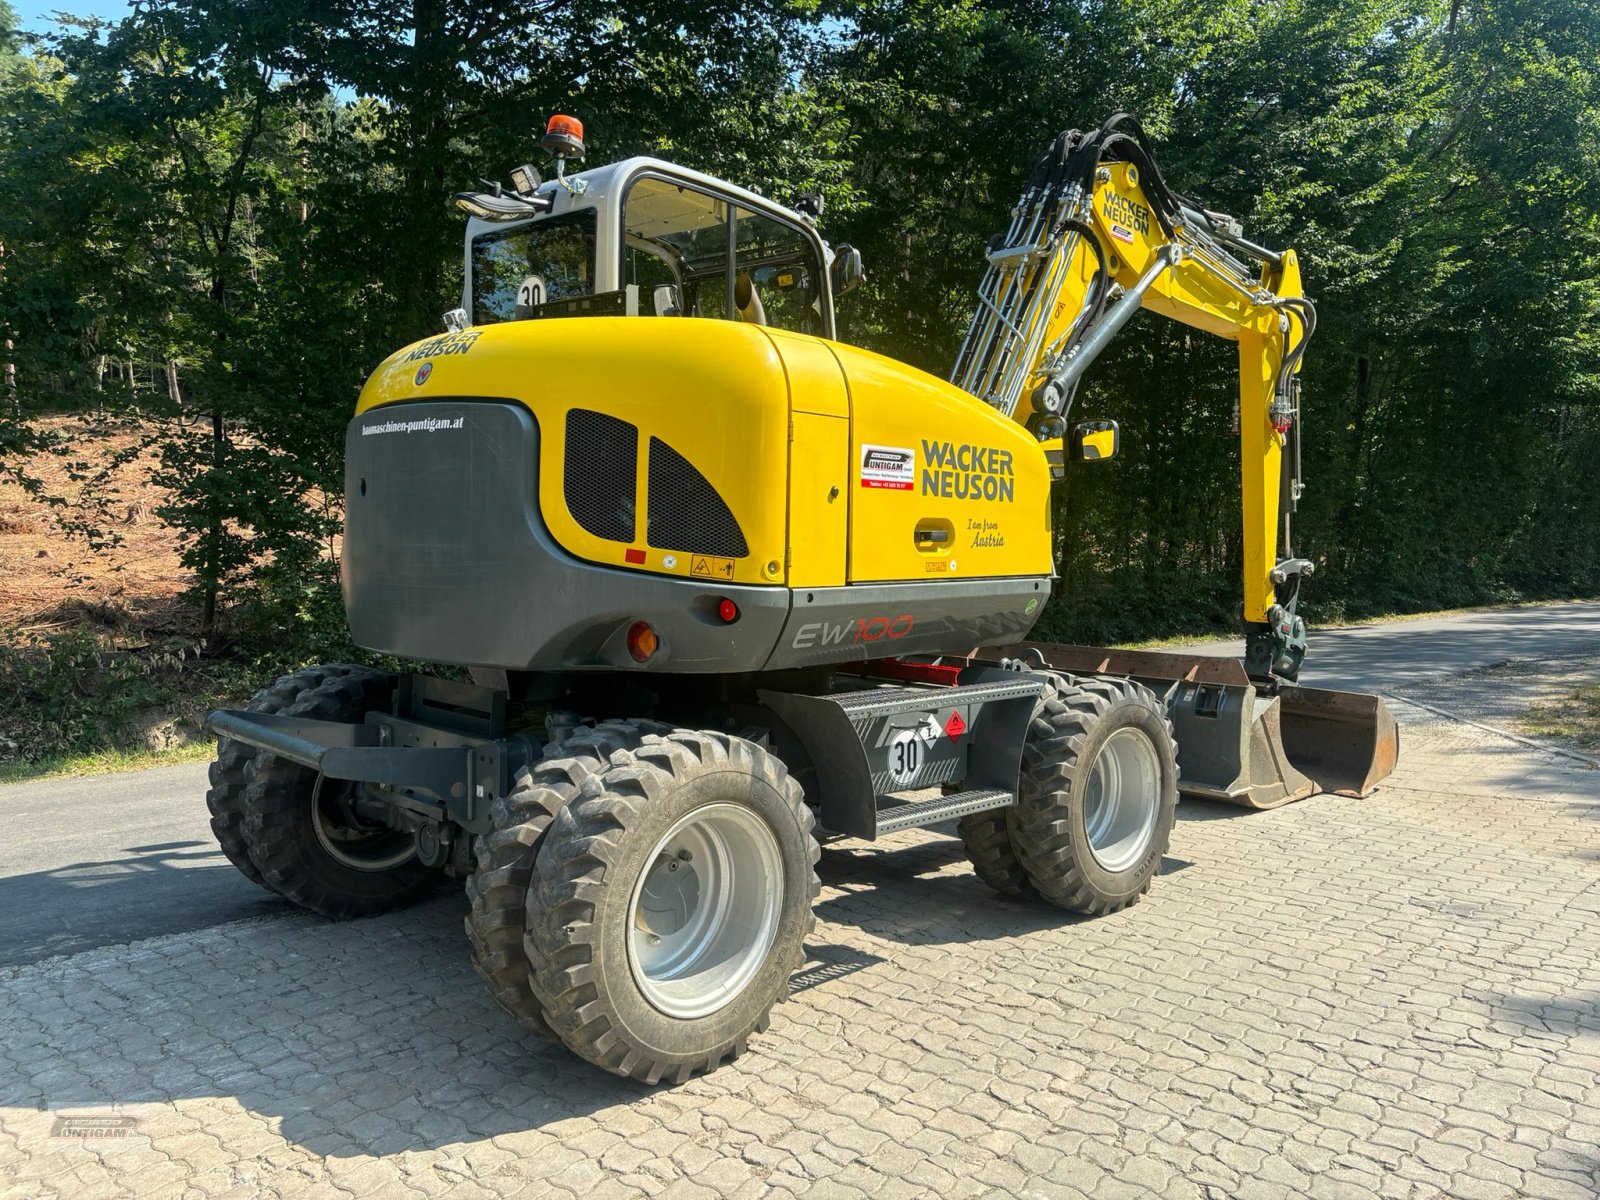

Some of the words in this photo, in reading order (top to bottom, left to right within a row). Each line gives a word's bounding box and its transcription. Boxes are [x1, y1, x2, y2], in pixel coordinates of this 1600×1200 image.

[1104, 188, 1150, 219] WACKER
[1103, 203, 1150, 236] NEUSON
[521, 283, 541, 306] 30
[405, 341, 475, 363] NEUSON
[361, 416, 465, 436] baumaschinen-puntigam.at
[921, 439, 1014, 476] WACKER
[922, 469, 1014, 503] NEUSON
[970, 531, 1005, 549] Austria
[894, 738, 917, 775] 30
